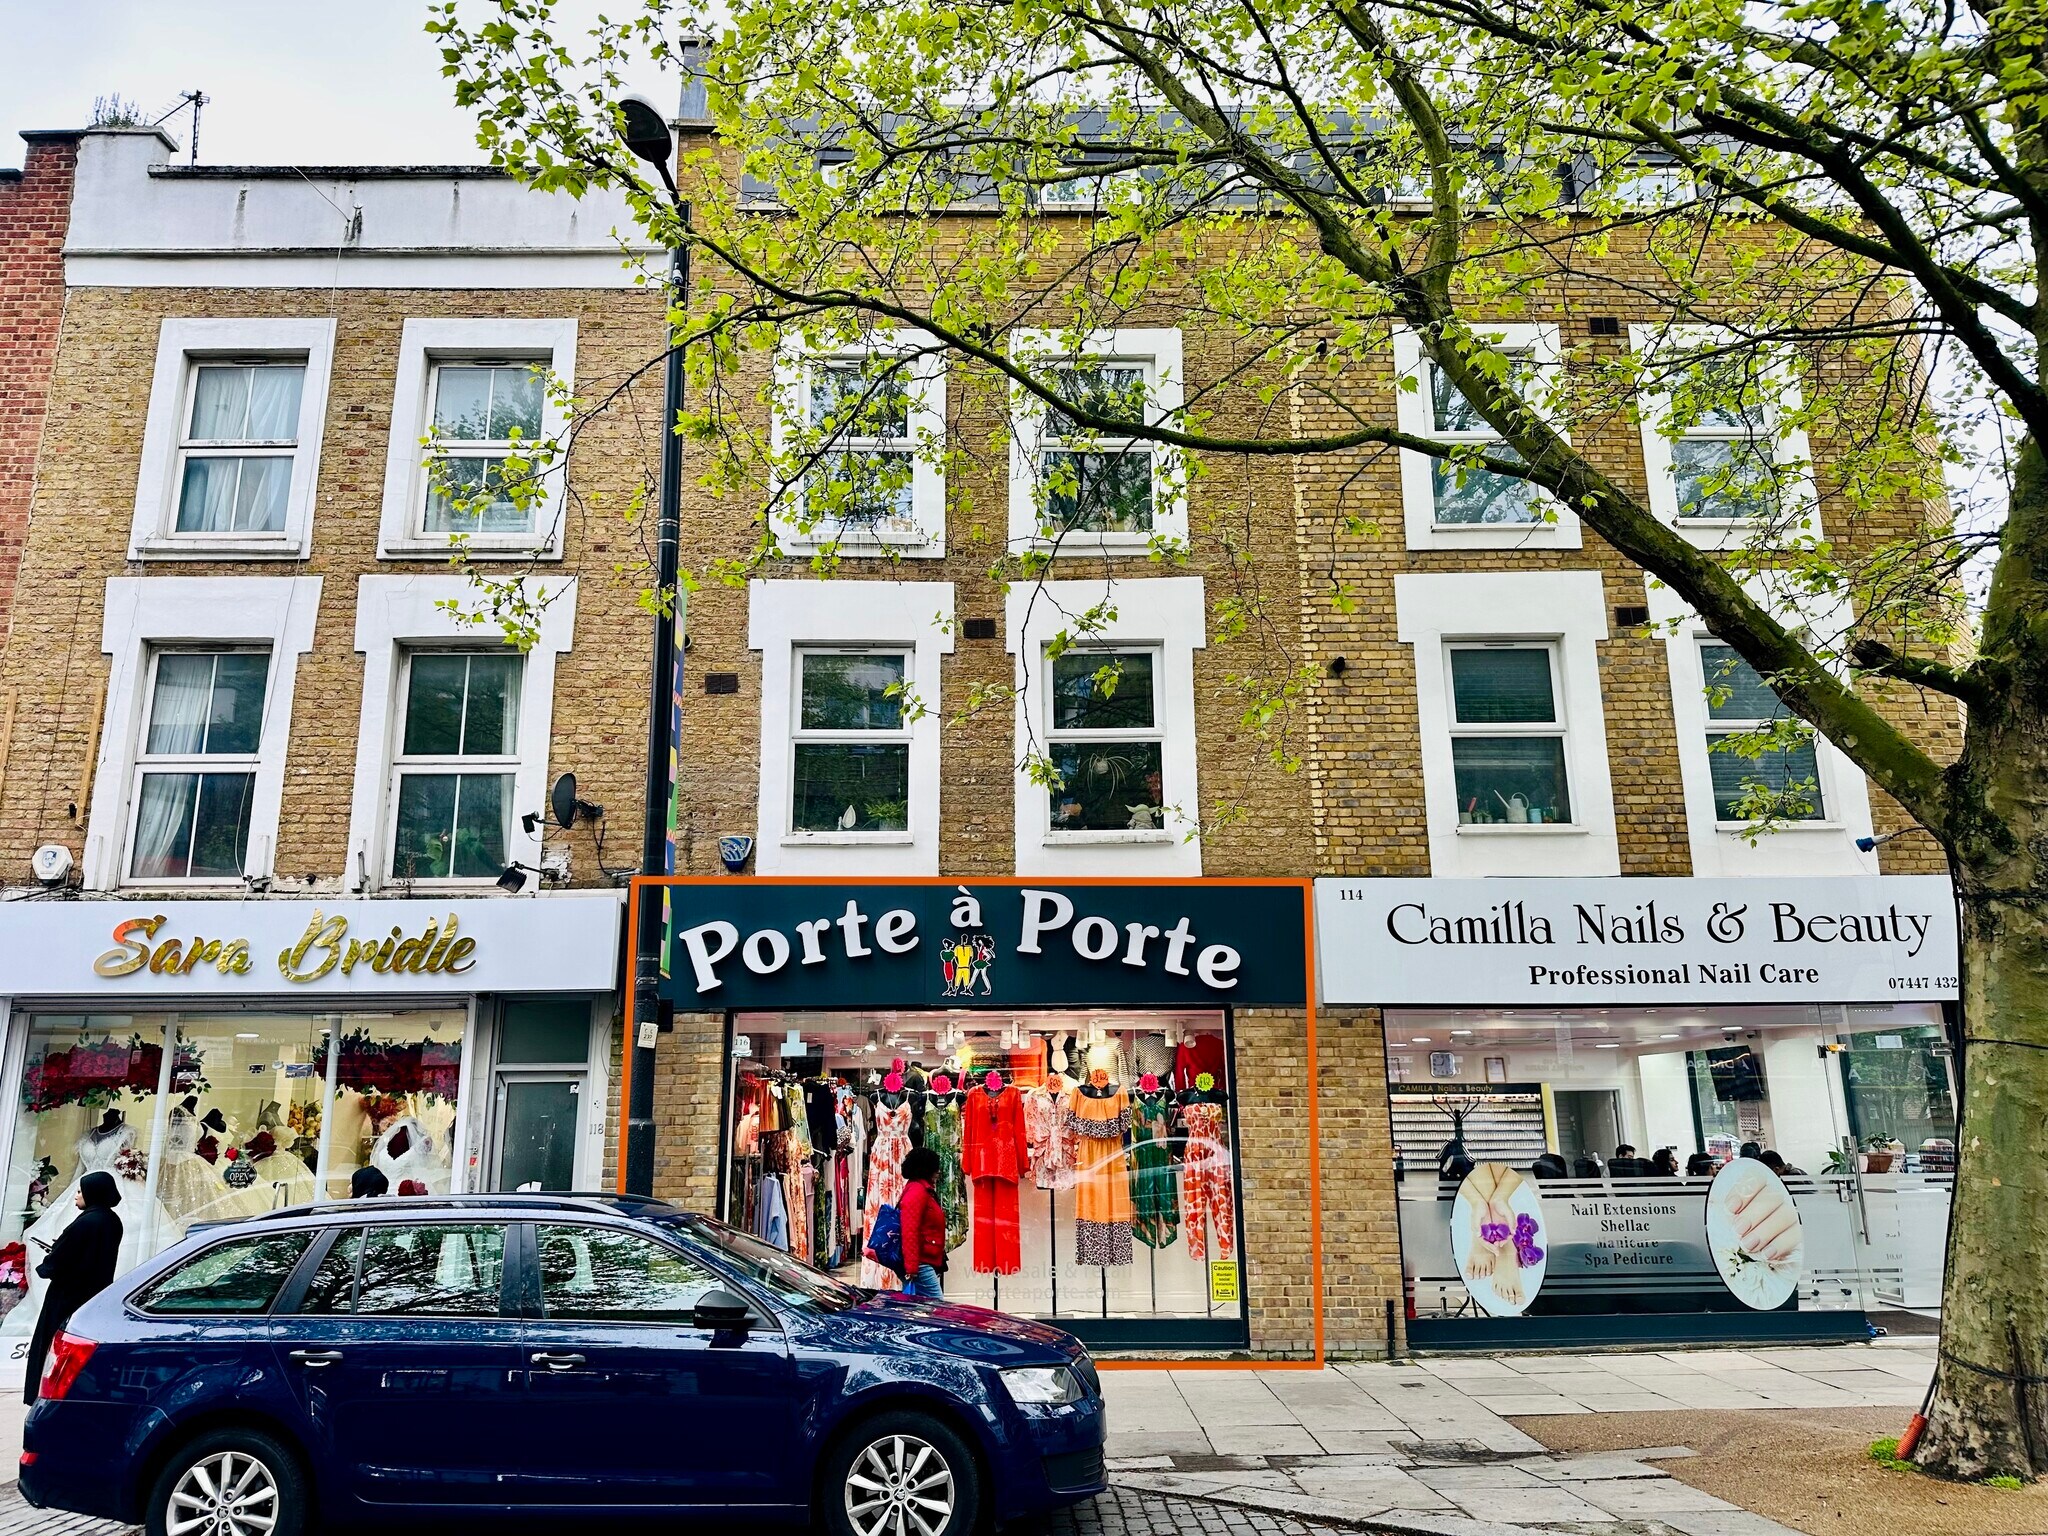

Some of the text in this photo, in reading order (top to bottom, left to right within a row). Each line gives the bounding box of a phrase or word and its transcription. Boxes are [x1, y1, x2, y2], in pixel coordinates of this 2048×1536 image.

[1340, 889, 1363, 901] 114
[1386, 899, 1933, 958] Camilla Nails & Beauty
[92, 907, 478, 984] Sara Bridle
[678, 885, 1241, 993] Porte à Porte
[1528, 963, 1820, 985] Professional Nail Care
[1888, 976, 1959, 989] 07447 432
[735, 1038, 749, 1046] 116
[1399, 1084, 1434, 1093] CAMILLA
[1437, 1084, 1457, 1093] Nails
[1466, 1084, 1493, 1093] Beauty
[589, 1123, 604, 1135] 118
[230, 1172, 249, 1181] OPEN
[1571, 1202, 1677, 1216] Nail Extensions
[1600, 1219, 1651, 1232] Shellac
[1584, 1252, 1674, 1268] Spa Pedicure
[963, 1261, 1057, 1279] wholesale
[1065, 1262, 1078, 1279] &
[974, 1286, 1121, 1303] porteaporte.com
